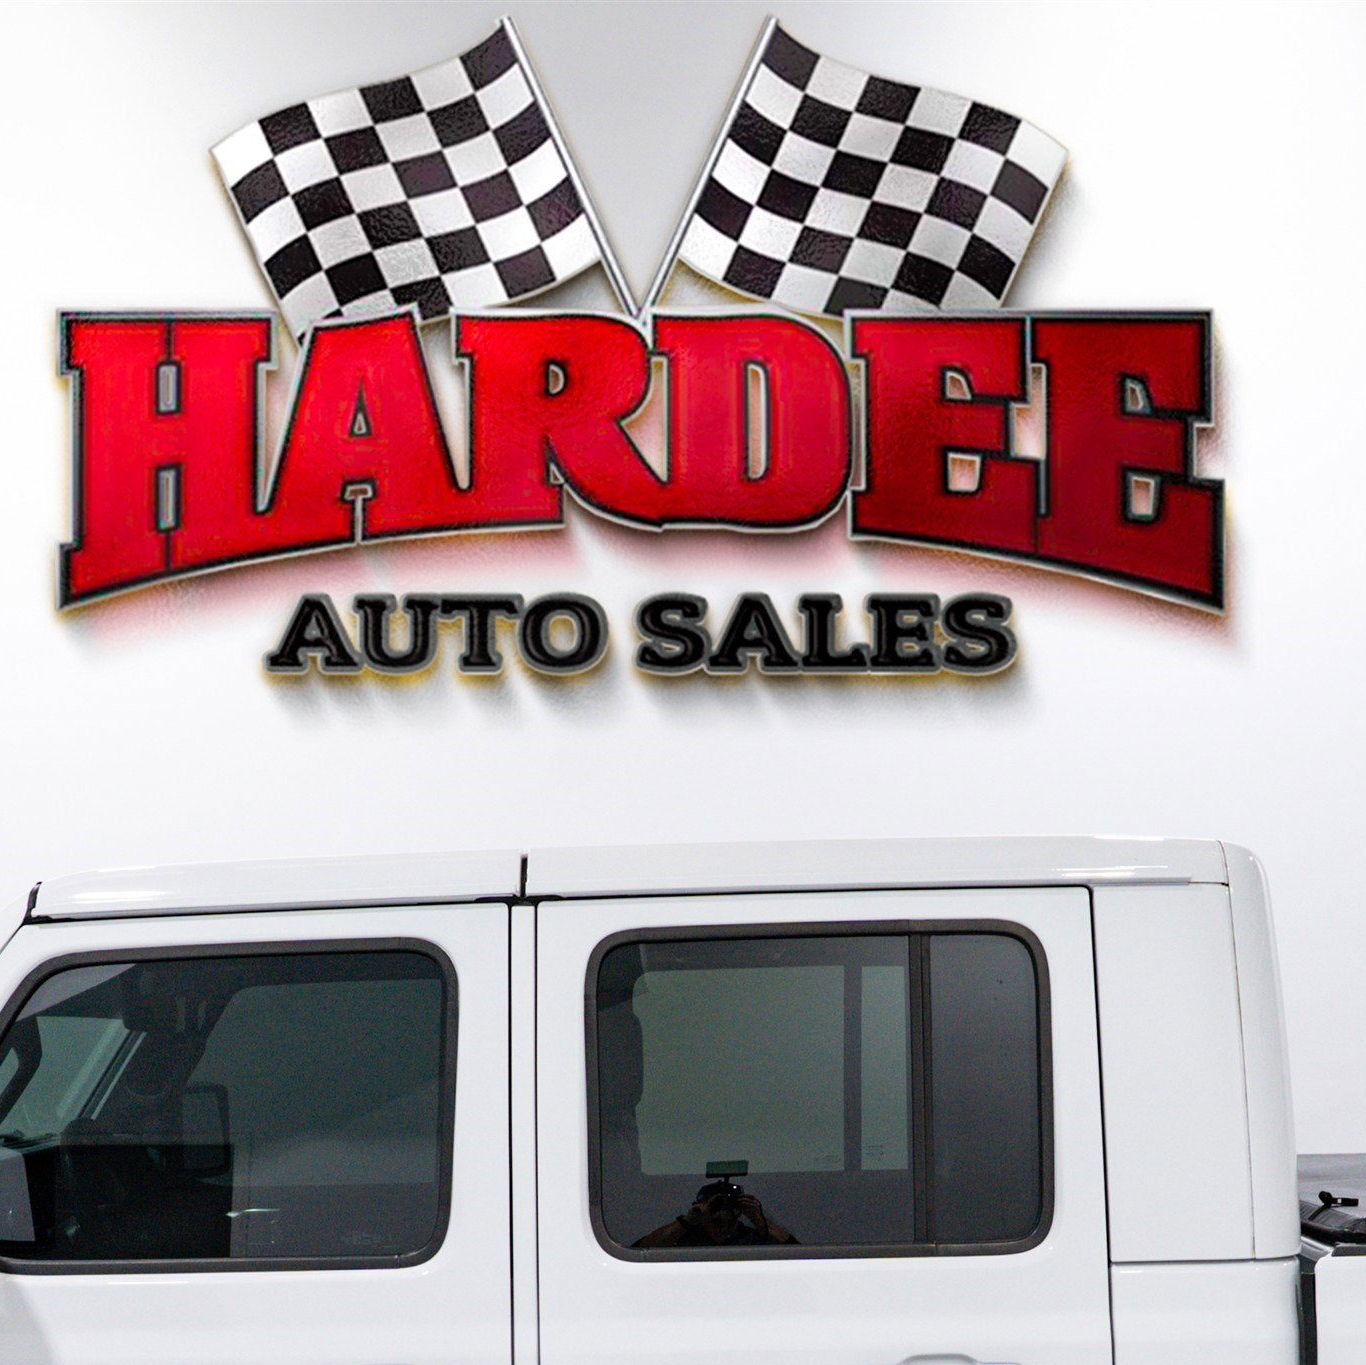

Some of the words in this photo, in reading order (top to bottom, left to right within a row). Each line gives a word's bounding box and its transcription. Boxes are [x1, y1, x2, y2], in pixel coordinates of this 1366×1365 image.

[59, 309, 1227, 615] HARDEE
[265, 591, 611, 676] AUTO
[633, 590, 1019, 678] SALES
